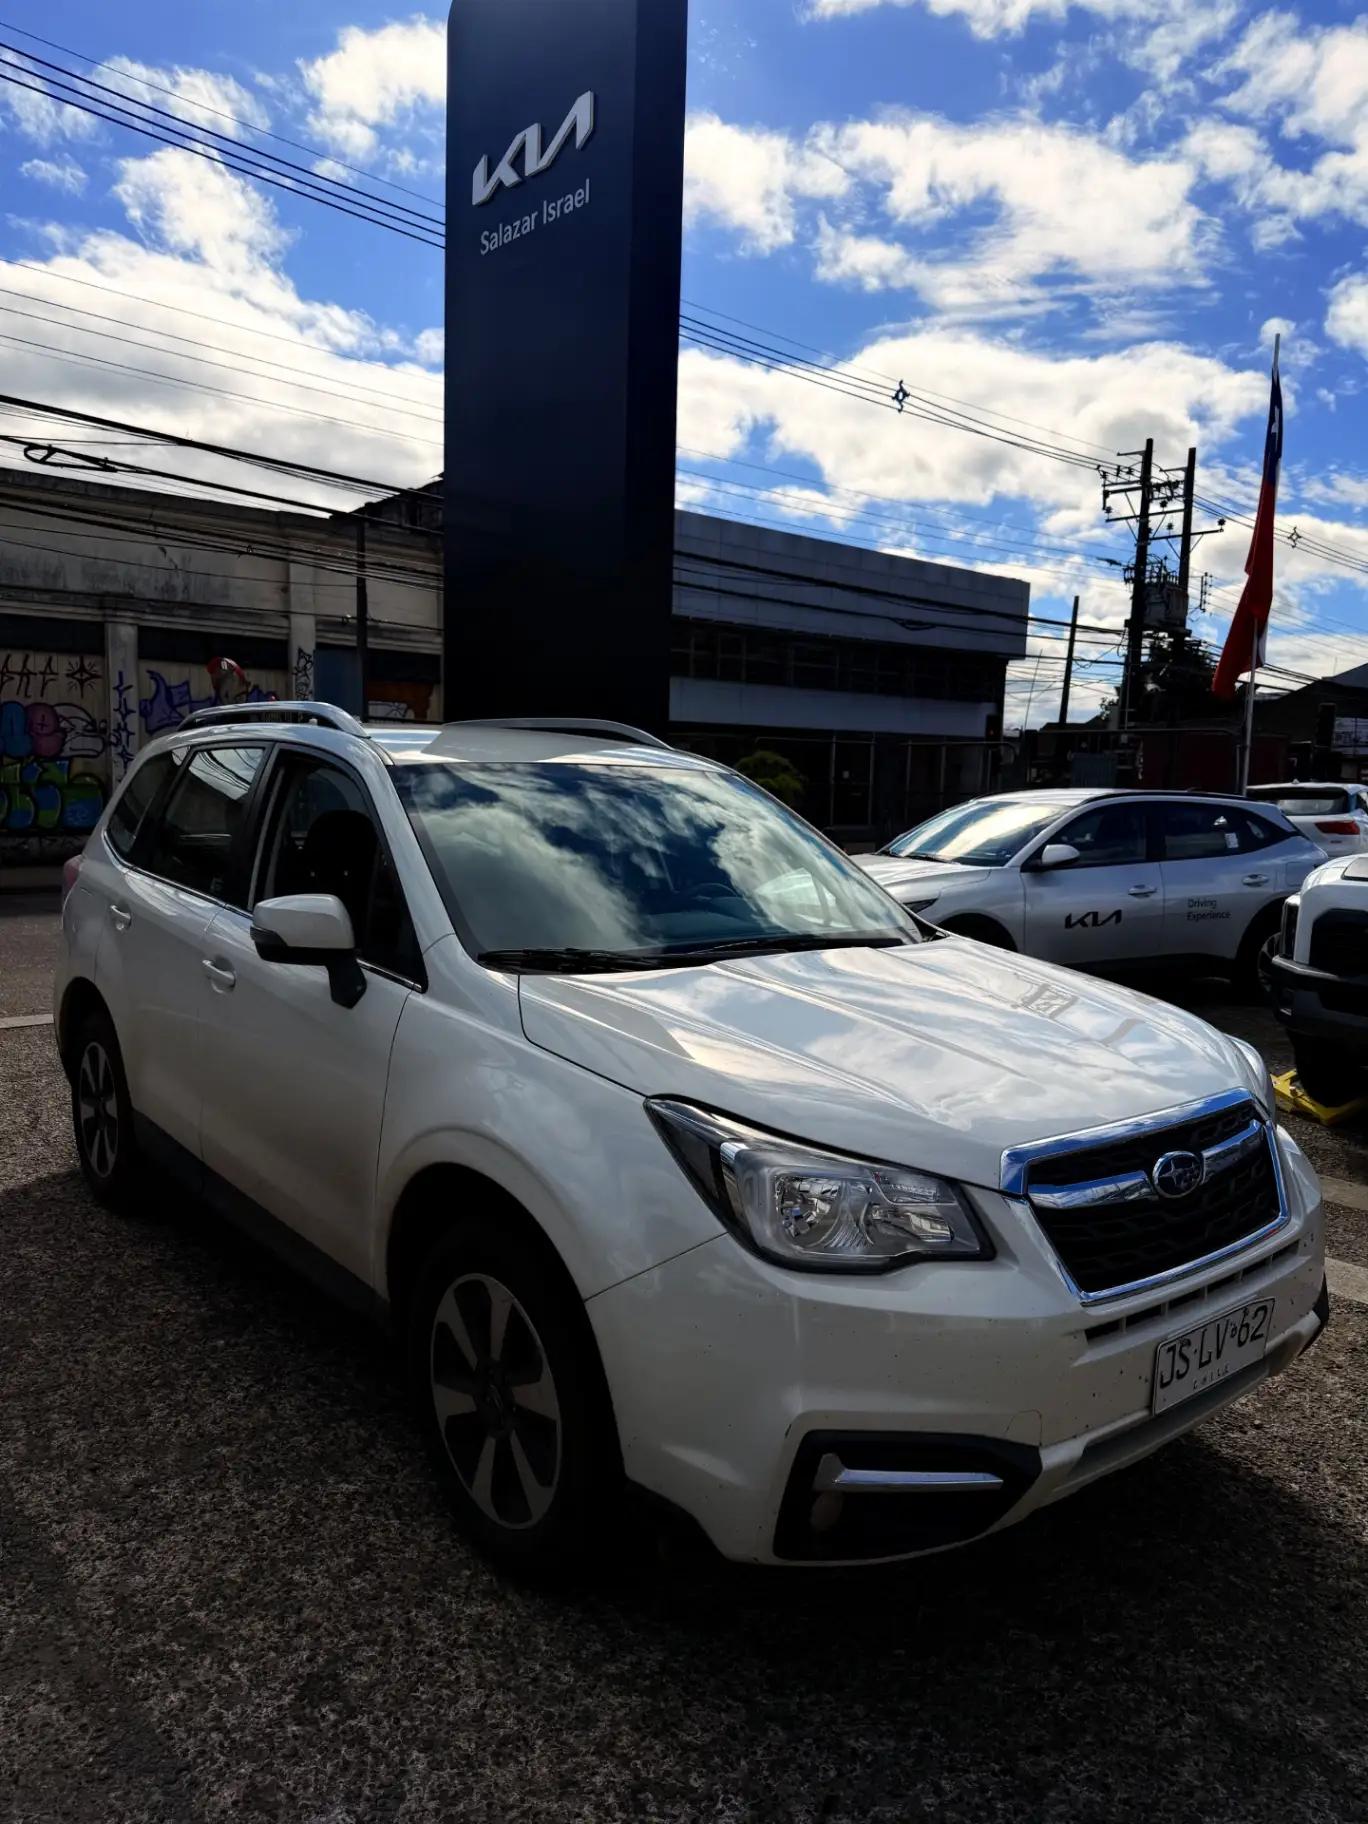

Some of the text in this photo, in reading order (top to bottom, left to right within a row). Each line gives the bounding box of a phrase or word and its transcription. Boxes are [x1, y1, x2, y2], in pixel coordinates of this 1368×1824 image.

[472, 90, 594, 206] KIA
[480, 178, 590, 256] Salazar Israel
[1187, 898, 1217, 910] Driving
[1064, 909, 1123, 929] KIA
[1187, 911, 1232, 922] Experience
